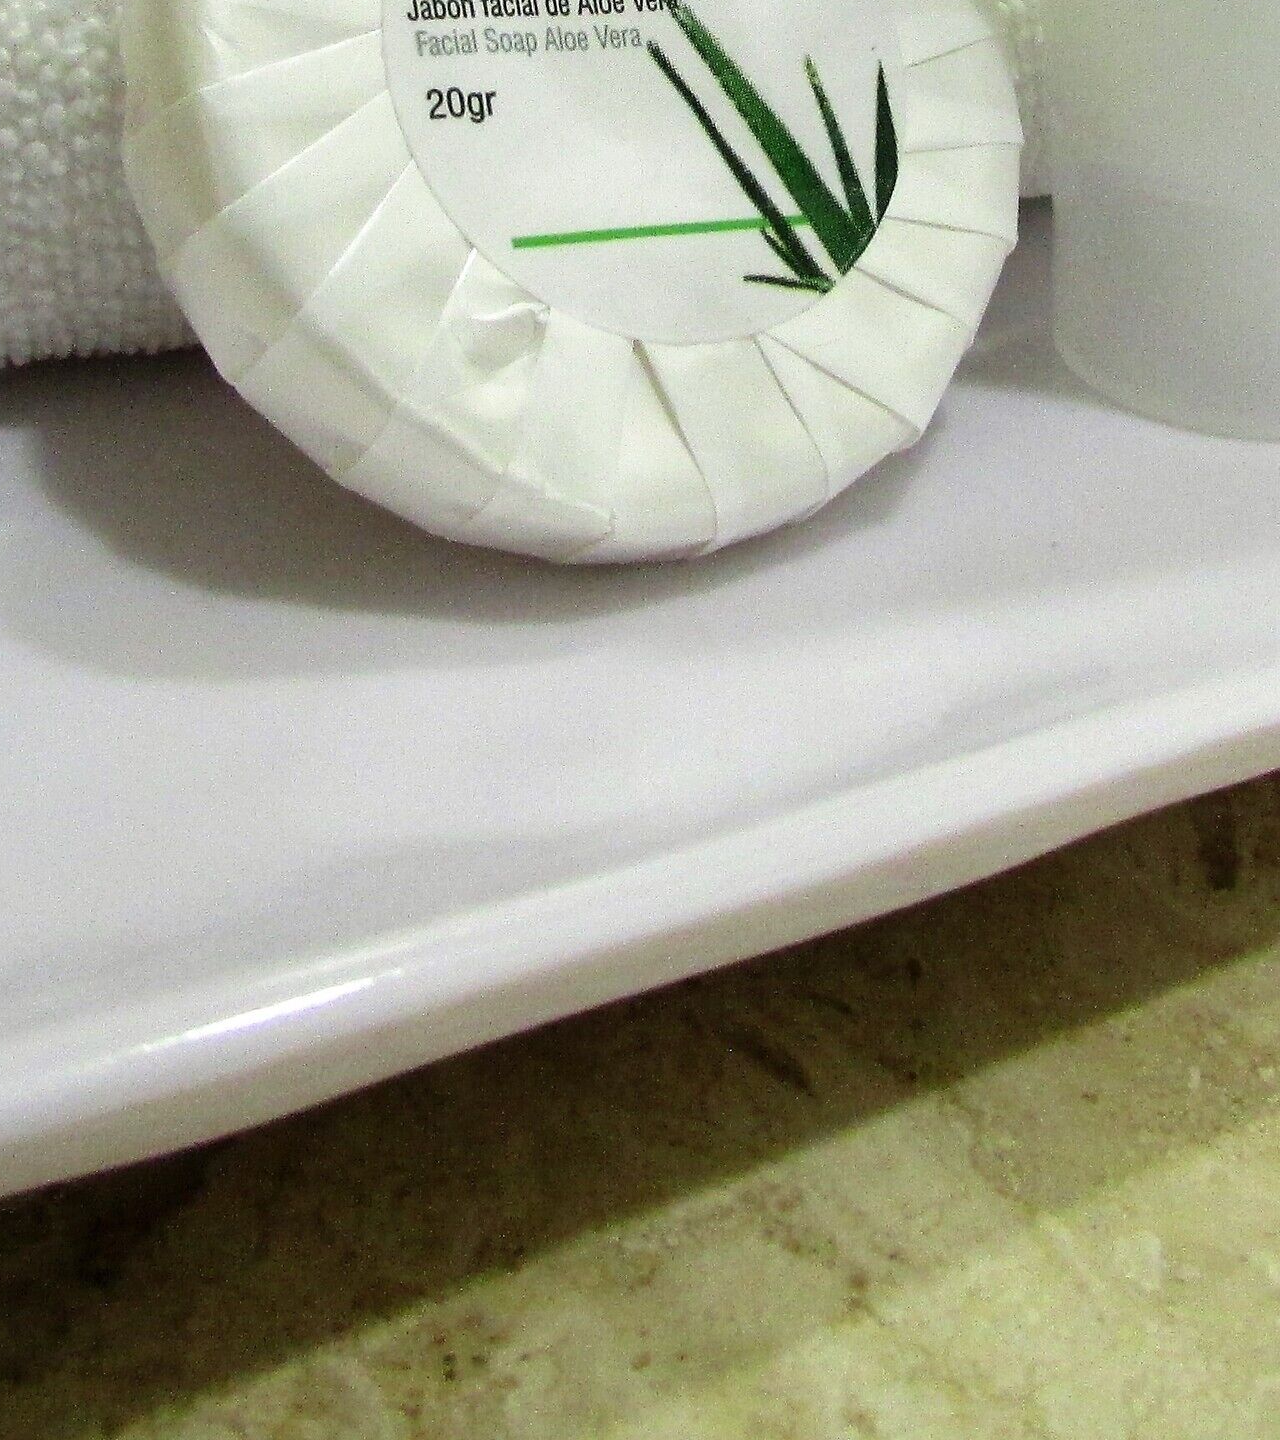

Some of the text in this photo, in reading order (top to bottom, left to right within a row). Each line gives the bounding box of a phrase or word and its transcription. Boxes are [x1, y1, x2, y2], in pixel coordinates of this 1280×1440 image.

[415, 23, 642, 57] Facial Soap Aloe Vera
[426, 86, 497, 124] 20gr
